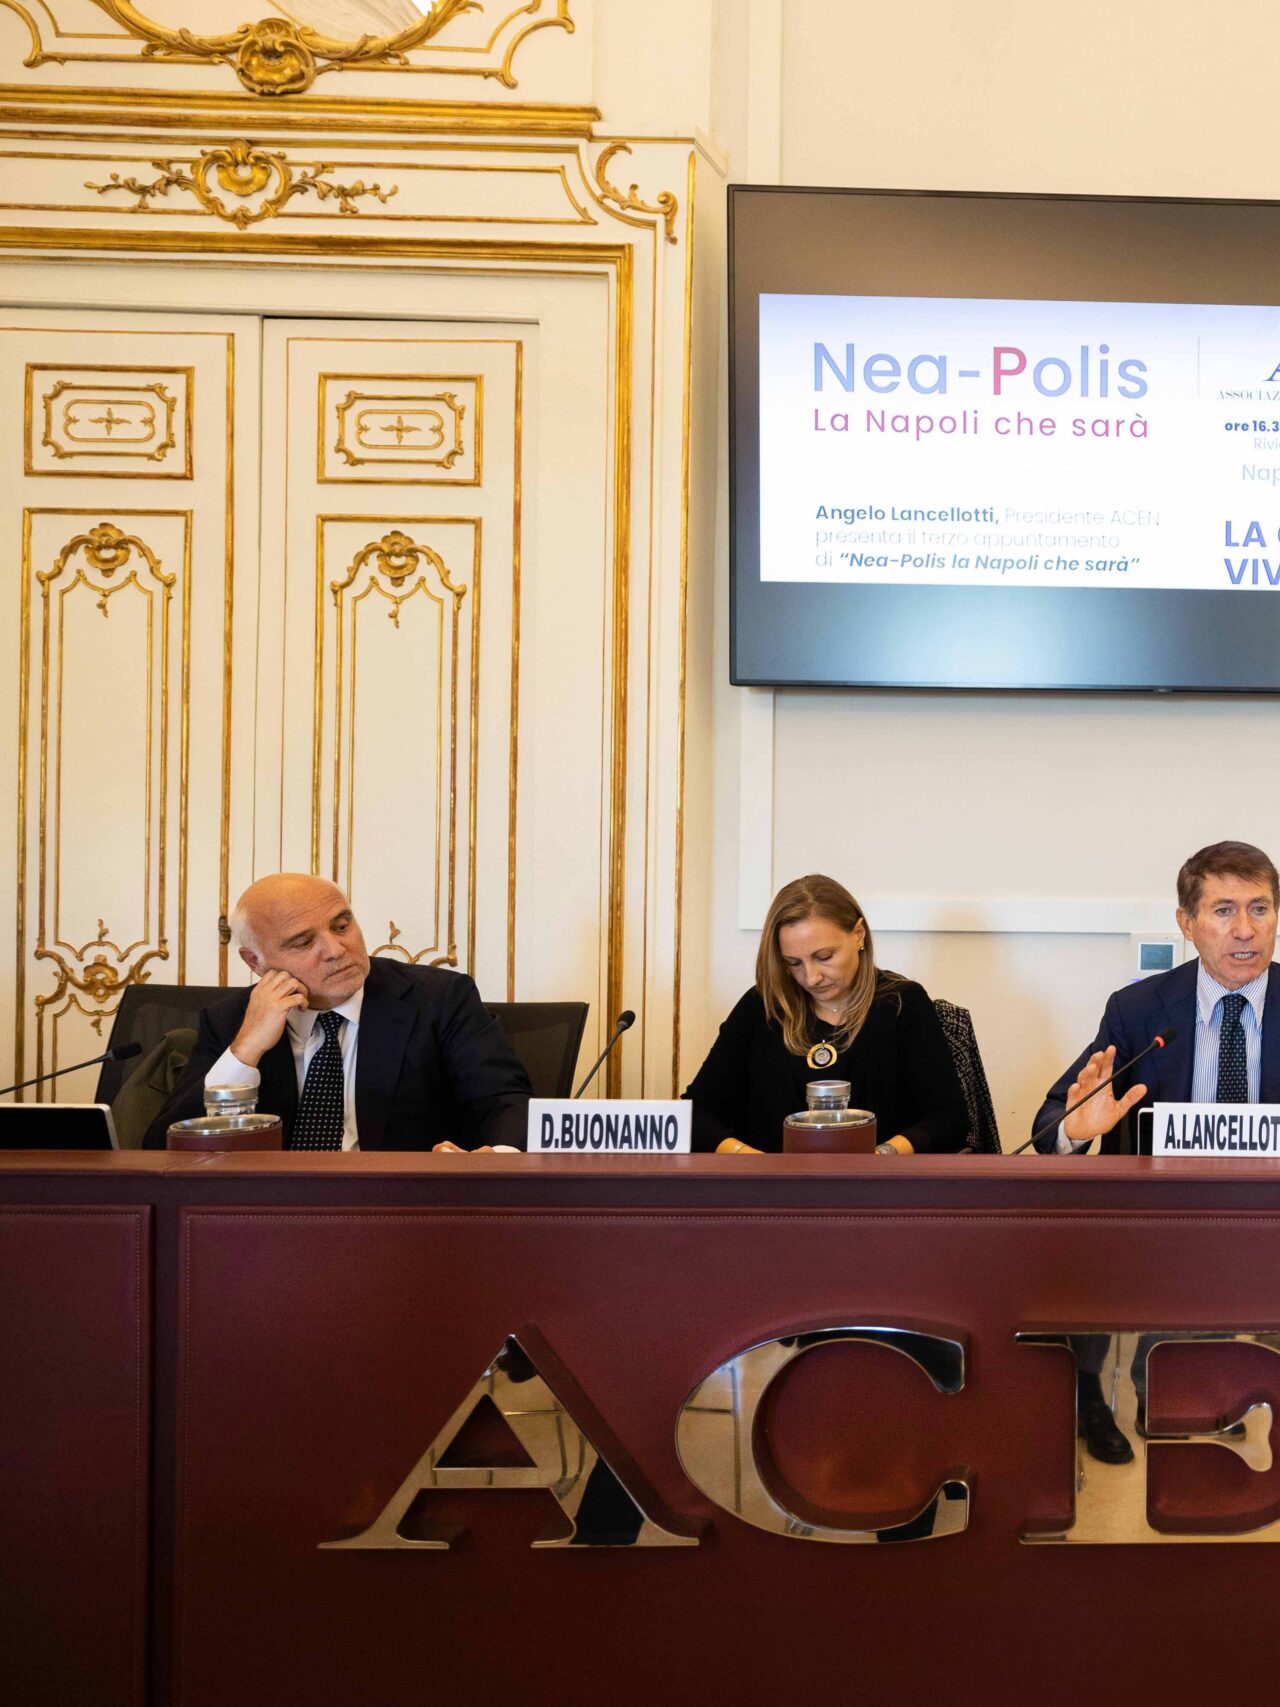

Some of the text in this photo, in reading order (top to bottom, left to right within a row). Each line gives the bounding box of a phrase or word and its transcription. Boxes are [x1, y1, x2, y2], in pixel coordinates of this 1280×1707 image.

[813, 342, 1149, 399] Nea-Polis
[813, 408, 1149, 441] La Napoli che sarà
[1224, 420, 1250, 433] ore
[815, 504, 1161, 527] Angelo Lancellotti, Presidente ACEN
[815, 528, 1121, 551] presenta il terzo appuntamento
[1224, 520, 1267, 548] LA
[815, 550, 833, 568] di
[951, 553, 971, 569] la
[974, 554, 1039, 575] Napoli
[1043, 556, 1081, 572] che
[540, 1113, 679, 1151] D.BUONANNO
